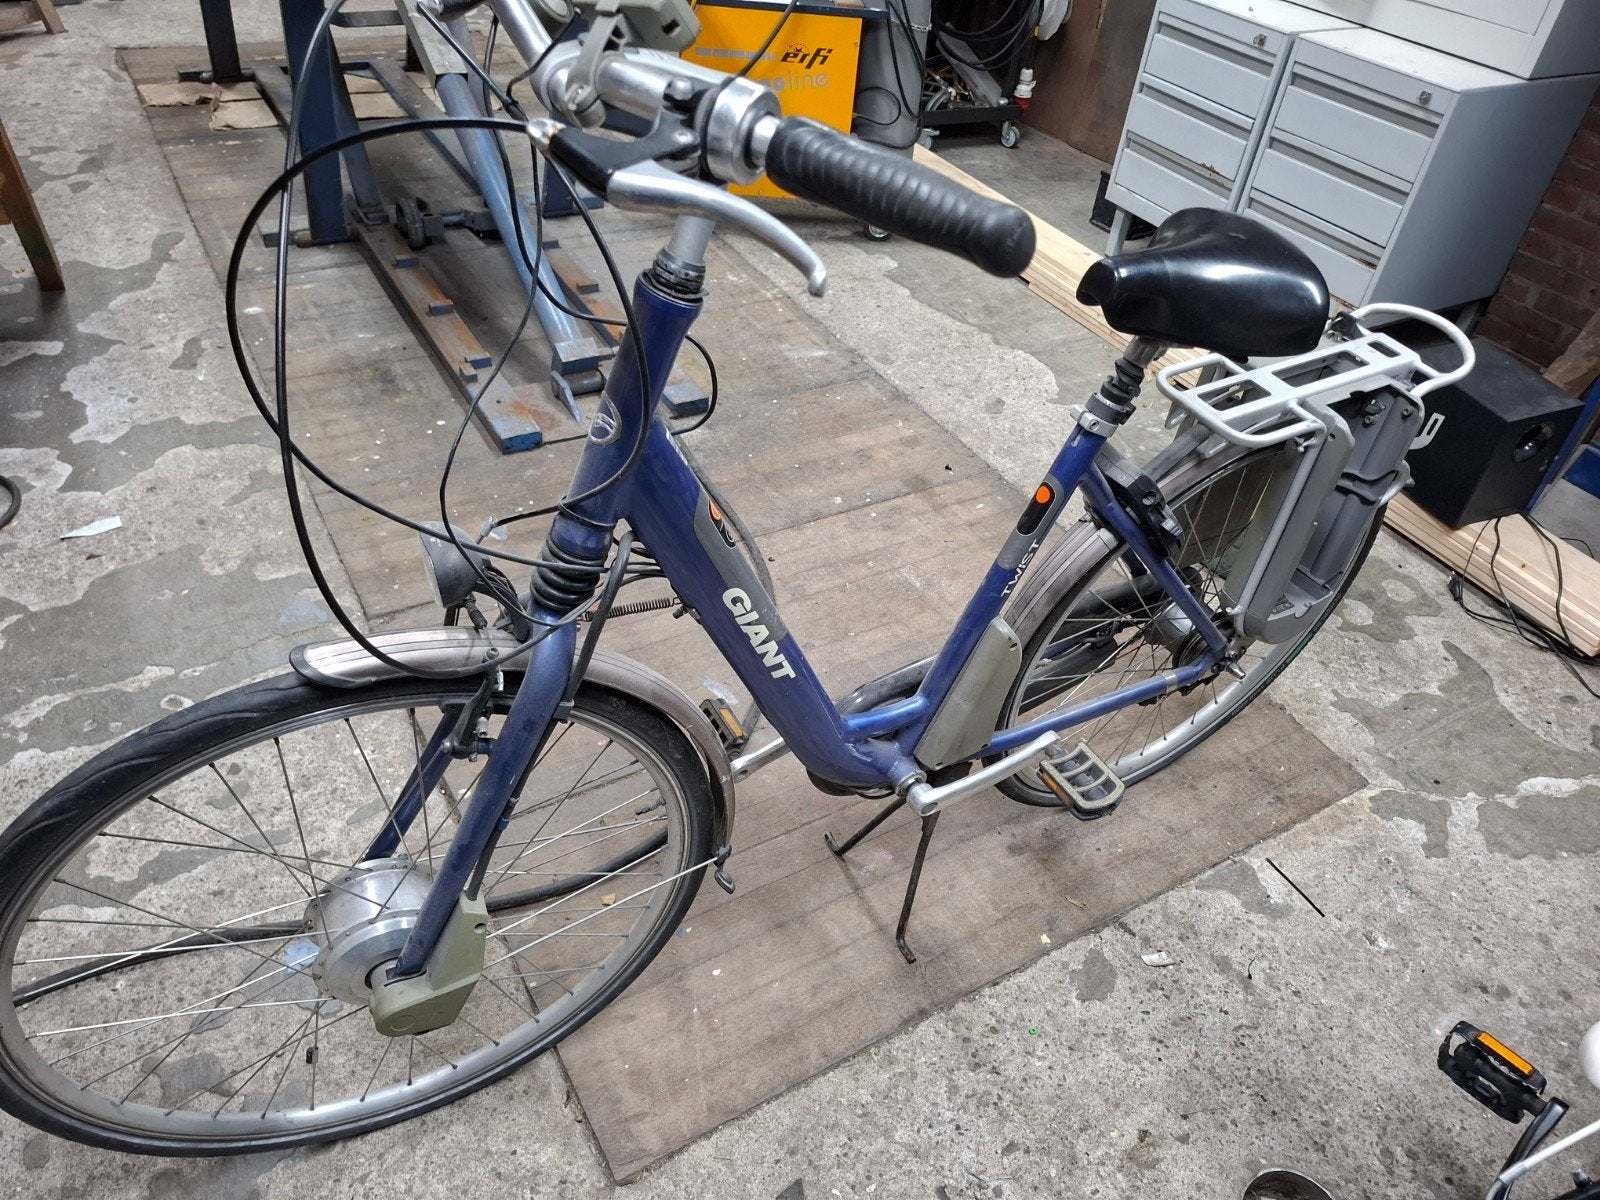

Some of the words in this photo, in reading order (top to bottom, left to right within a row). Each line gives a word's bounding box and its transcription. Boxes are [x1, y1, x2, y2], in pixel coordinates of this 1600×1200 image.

[780, 47, 833, 70] erfi
[1000, 538, 1040, 598] TWIST
[722, 587, 797, 680] GIANT
